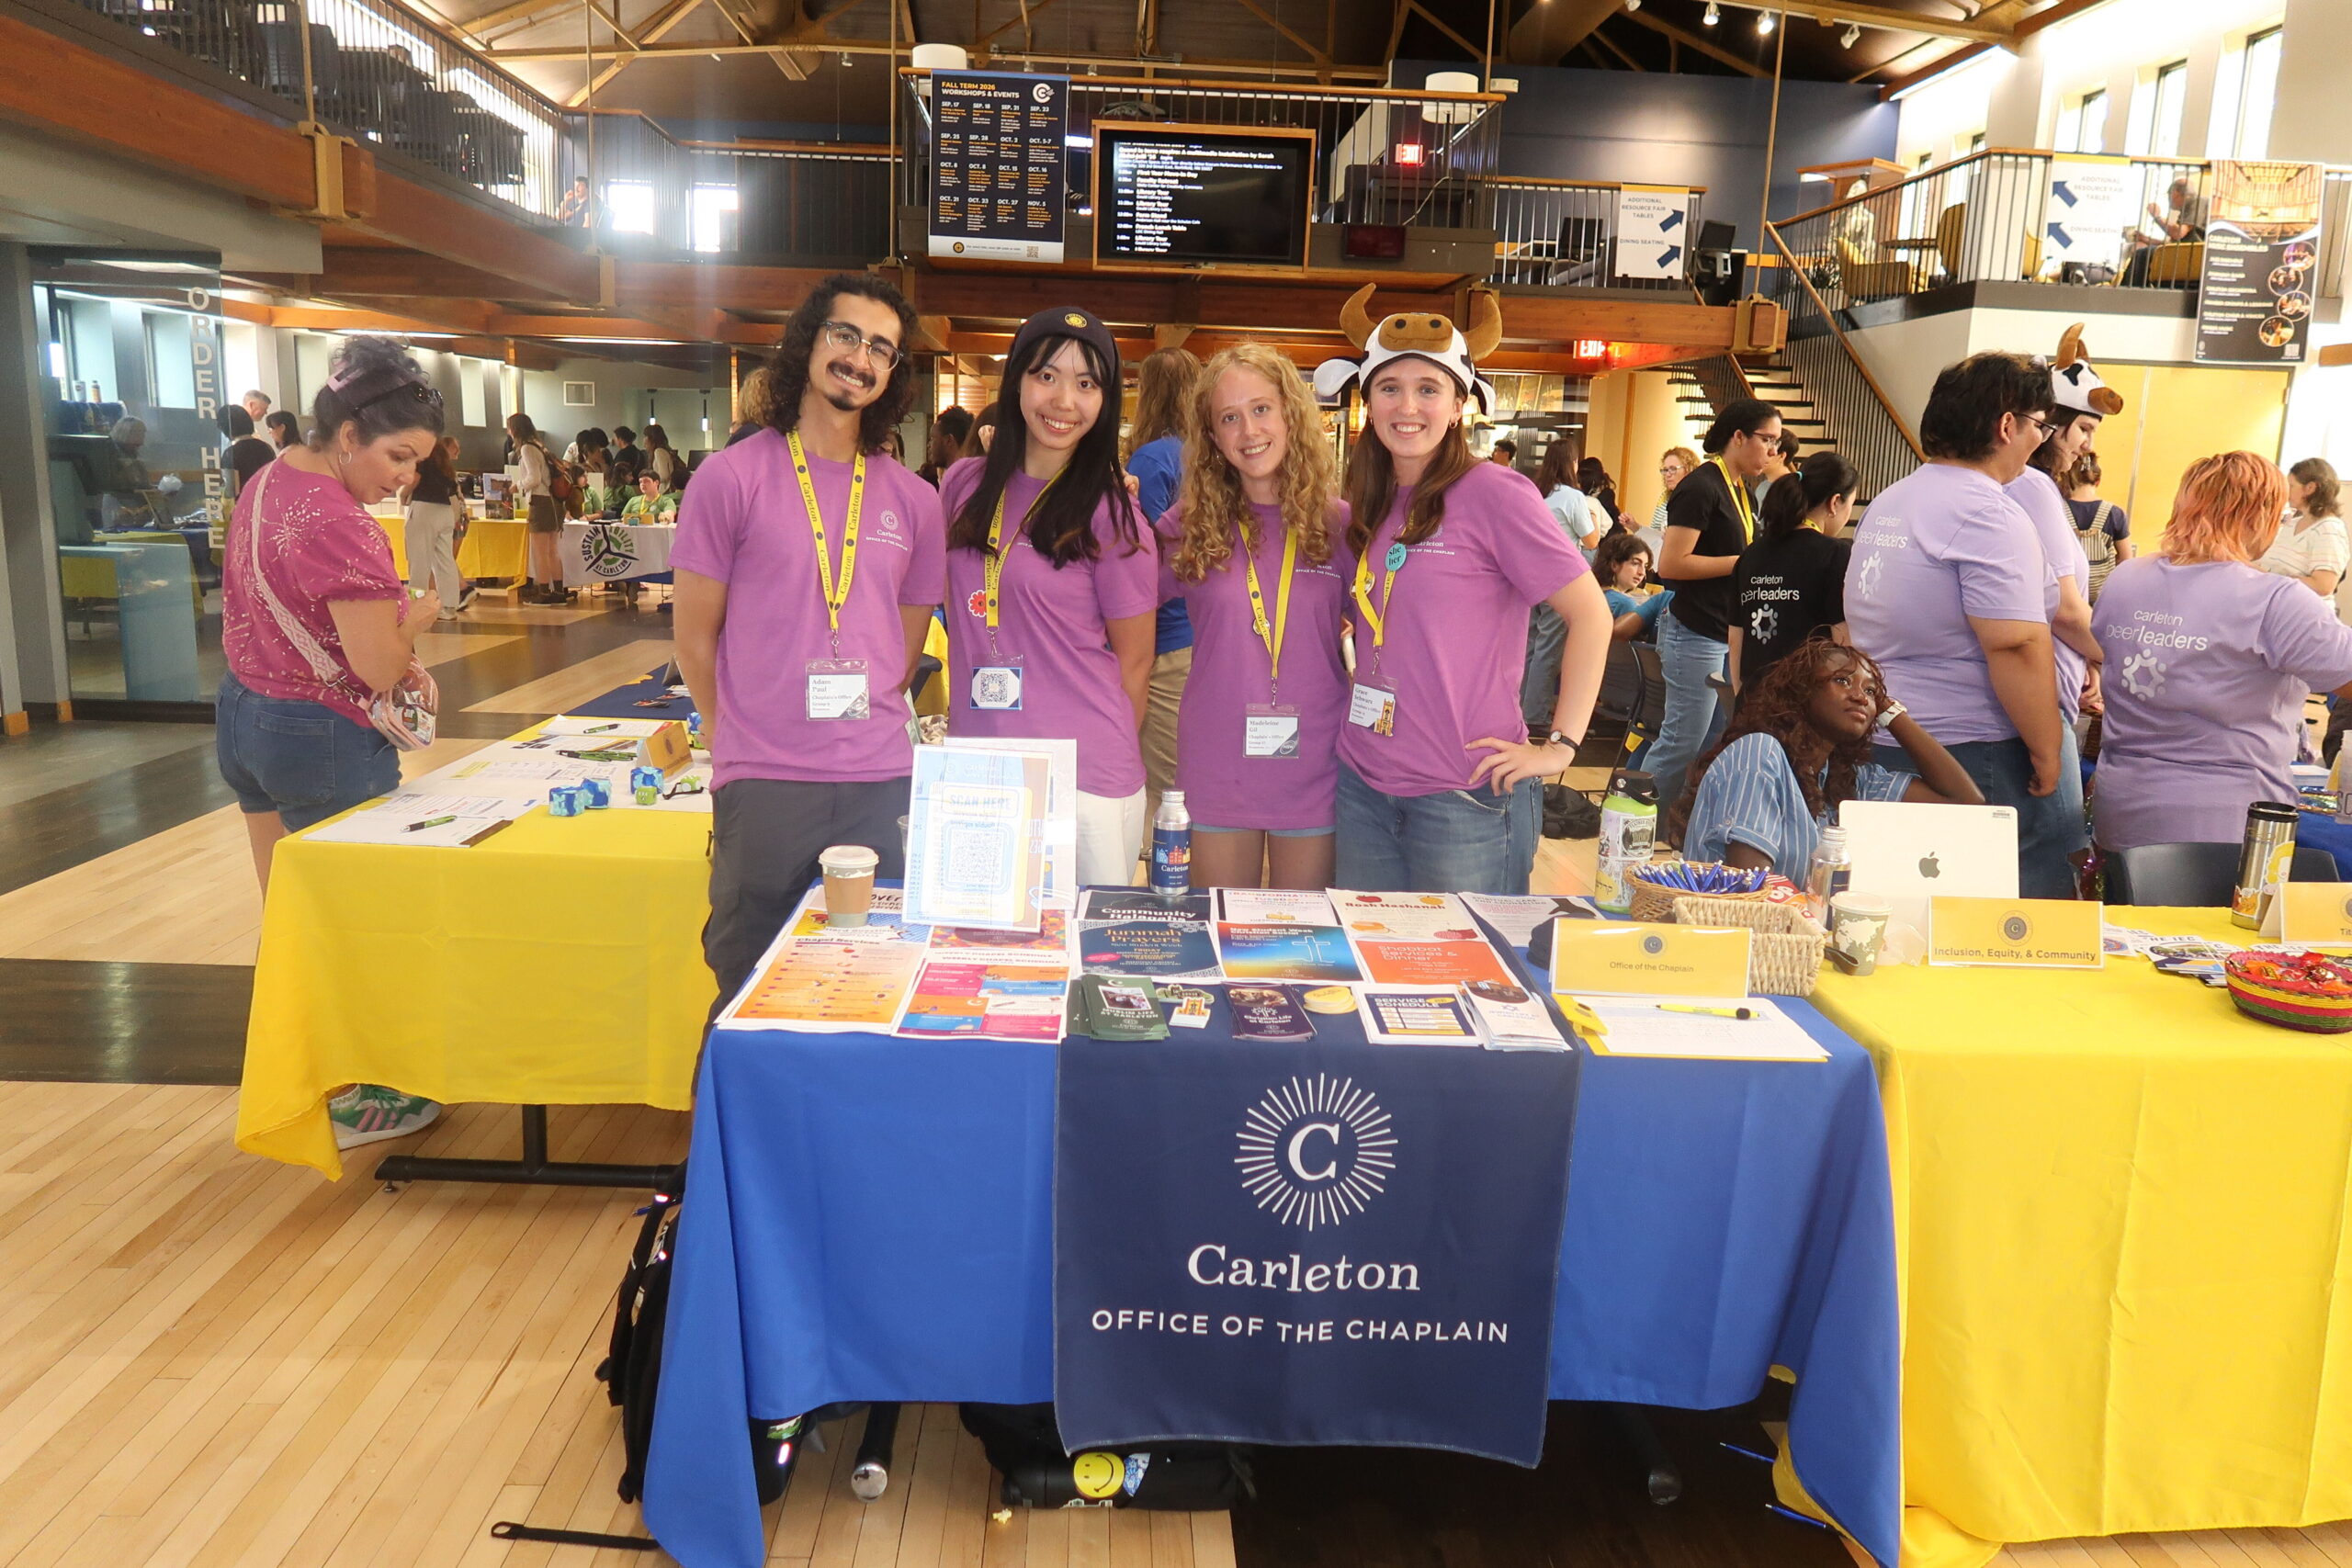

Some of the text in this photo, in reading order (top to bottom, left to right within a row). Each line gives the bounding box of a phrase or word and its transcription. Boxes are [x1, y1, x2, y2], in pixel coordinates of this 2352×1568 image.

[941, 88, 987, 97] WORKSHOPS
[187, 287, 217, 420] ORDER
[201, 446, 225, 549] HERE
[802, 481, 818, 523] Carleton
[848, 491, 861, 531] Carleton
[876, 529, 902, 541] Carleton
[1389, 547, 1402, 557] she
[1389, 555, 1402, 566] her
[820, 549, 831, 592] Carleton
[840, 556, 853, 594] Carleton
[1750, 575, 1783, 584] carleton
[2133, 610, 2183, 626] carleton
[1161, 864, 1189, 873] Carleton
[1102, 908, 1196, 918] Community
[1104, 929, 1183, 937] Jummah
[1111, 936, 1181, 944] Prayers
[1934, 947, 2097, 962] Inclusion, Equity, & Community
[1610, 961, 1634, 970] Office
[1634, 963, 1643, 971] of
[1658, 964, 1694, 974] Chaplain
[1288, 1122, 1340, 1181] C
[1188, 1244, 1420, 1292] Carleton
[1091, 1310, 1508, 1343] OFFICE OF THE CHAPLAIN
